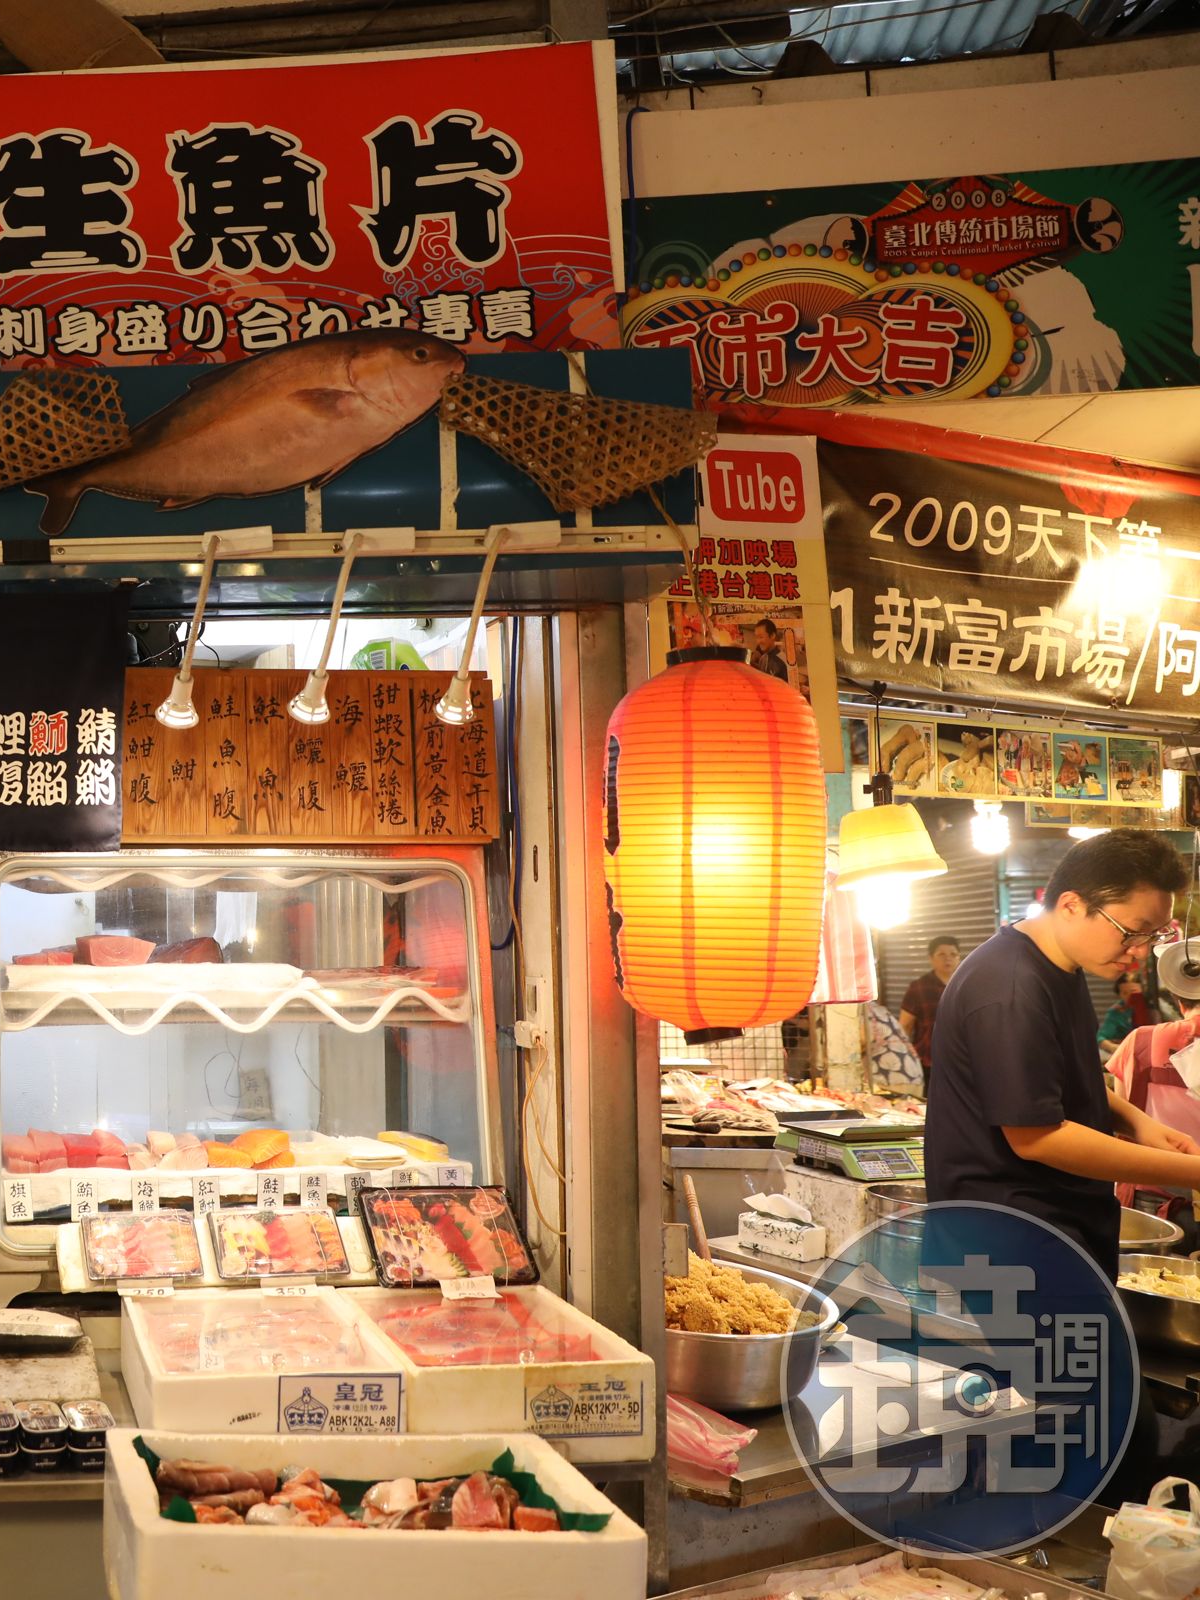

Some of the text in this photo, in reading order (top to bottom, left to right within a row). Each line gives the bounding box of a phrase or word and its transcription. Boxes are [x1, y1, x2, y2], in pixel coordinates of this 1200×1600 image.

[932, 190, 1006, 210] 2008
[883, 215, 1061, 249] 臺北傳統市場節
[911, 248, 938, 258] Taipei
[941, 244, 990, 257] Traditional
[992, 243, 1022, 253] Market
[1026, 238, 1060, 249] Festival
[714, 460, 797, 513] Tube
[249, 695, 285, 801] 鮭魚
[10, 1183, 28, 1218] 旗魚
[306, 1176, 321, 1208] 鮭魚
[334, 1382, 384, 1402] 皇冠
